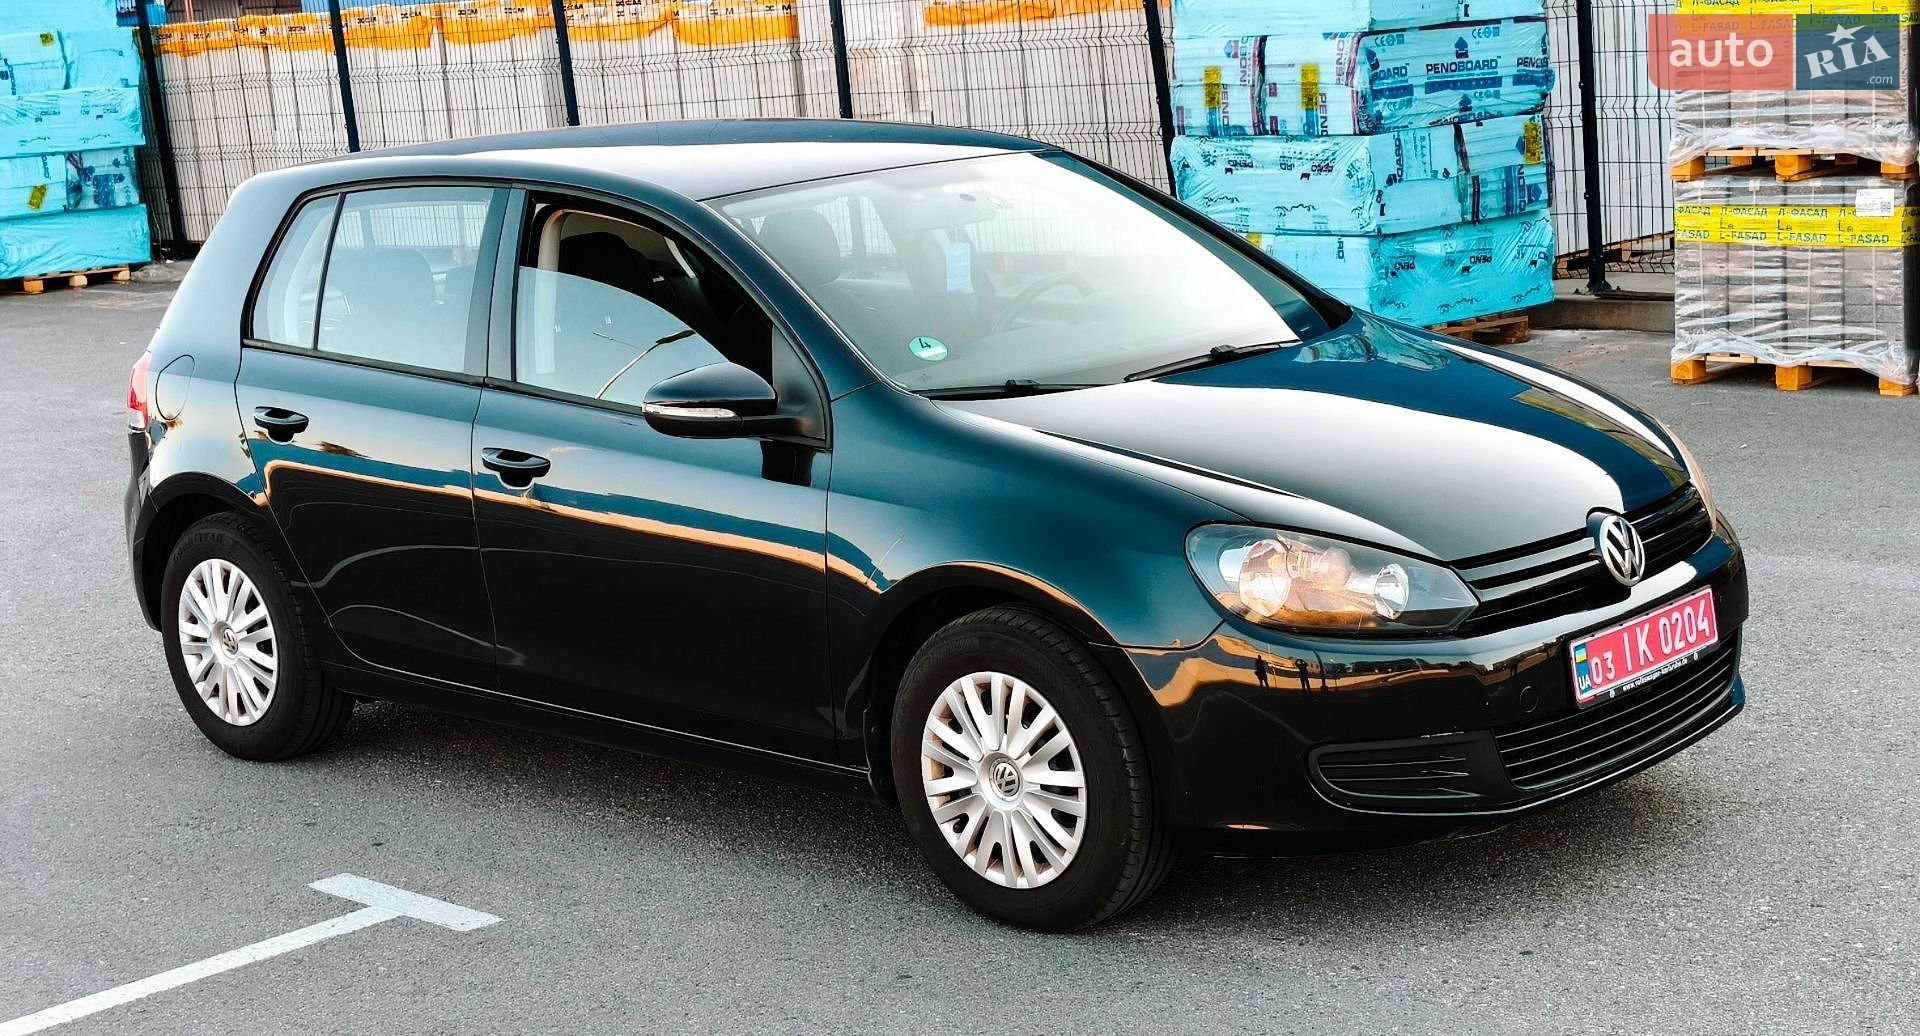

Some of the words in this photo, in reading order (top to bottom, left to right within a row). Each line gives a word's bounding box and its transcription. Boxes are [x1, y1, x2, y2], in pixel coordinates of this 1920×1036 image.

[1426, 58, 1499, 75] PENOBOARD
[1675, 206, 1711, 215] -ФАСАД
[1778, 208, 1828, 218] Л-ФАСАД
[1675, 230, 1709, 239] FASAD
[1720, 231, 1767, 241] L-FASAD
[1777, 233, 1827, 242] L-FASAD
[1838, 234, 1890, 244] L-FASAD
[1590, 650, 1616, 685] 03
[1622, 623, 1655, 672] IK
[1658, 600, 1711, 655] 0204
[1578, 676, 1592, 690] UA
